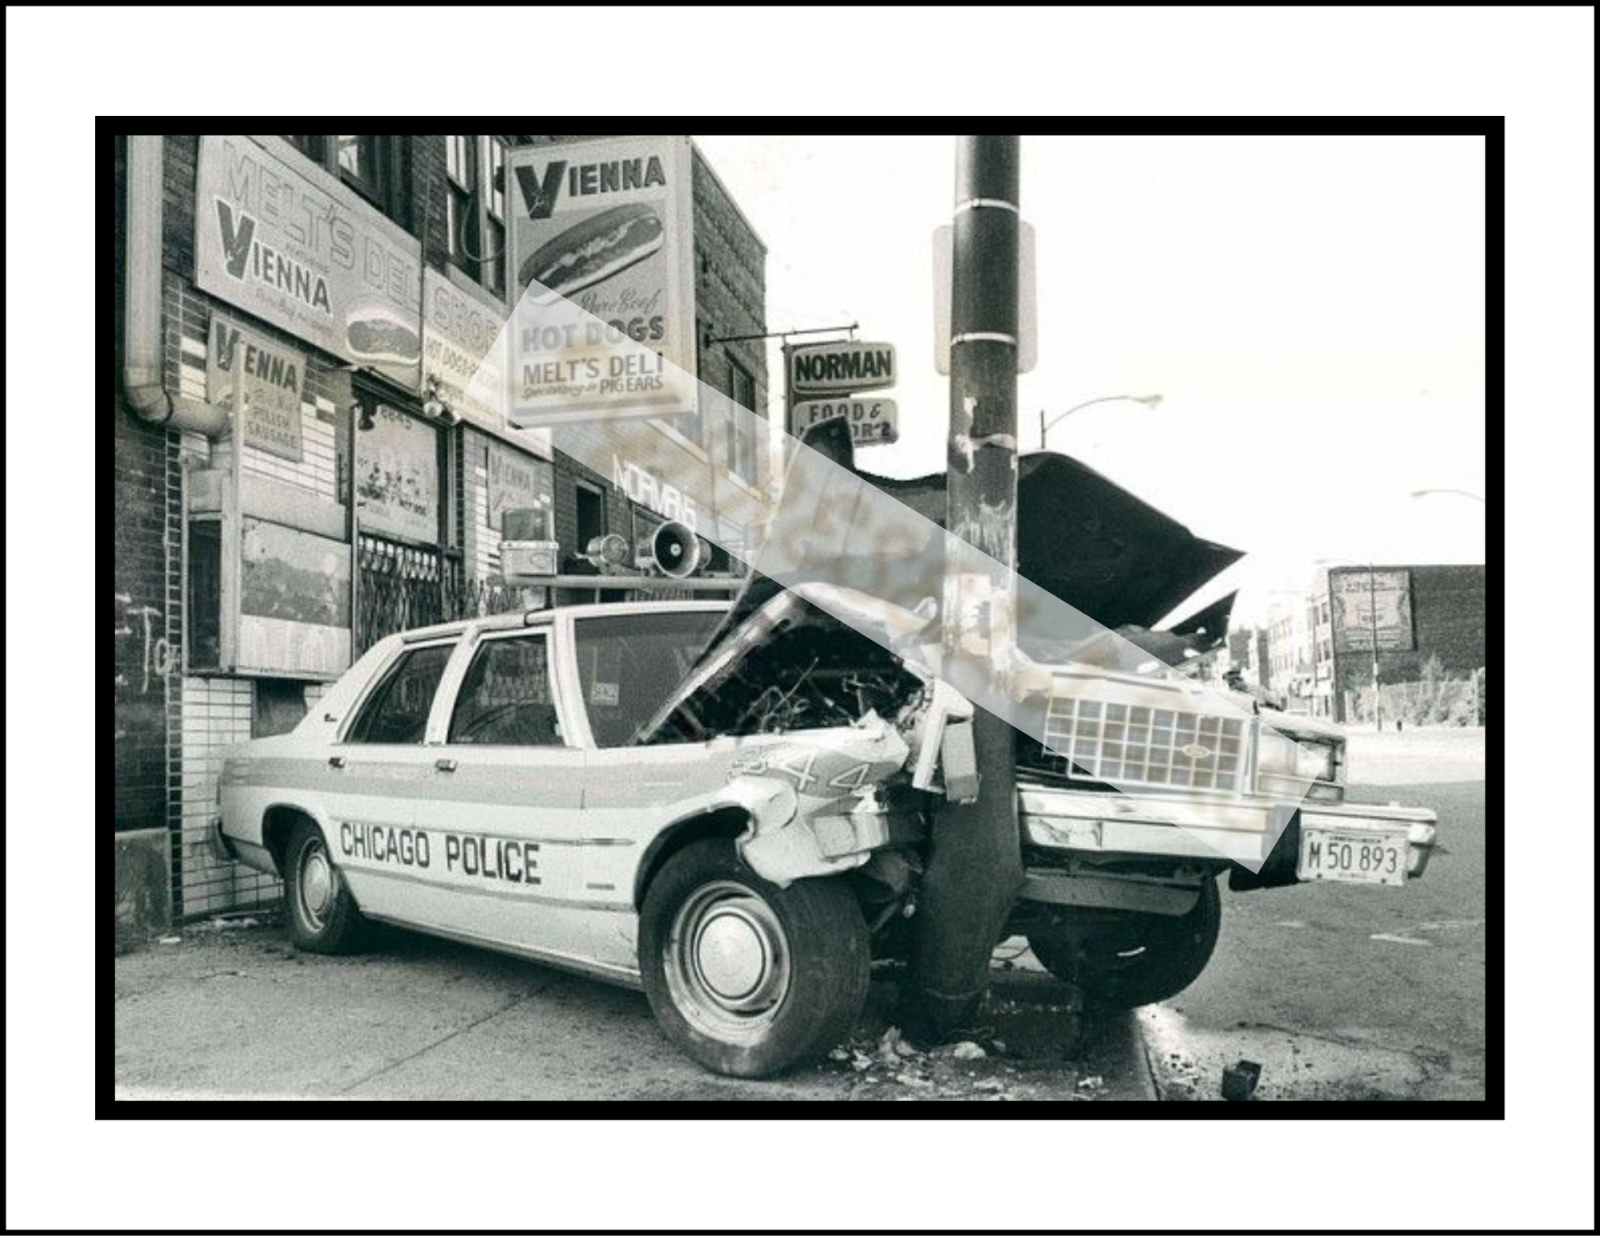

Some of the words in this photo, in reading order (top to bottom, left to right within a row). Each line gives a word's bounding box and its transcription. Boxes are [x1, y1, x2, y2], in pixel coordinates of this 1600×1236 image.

[224, 139, 356, 271] MELT'S
[514, 156, 666, 220] VIENNA
[215, 199, 331, 314] VIENNA
[522, 323, 579, 352] HOT
[586, 315, 664, 346] DOGS
[215, 322, 298, 394] VENNA
[523, 357, 600, 385] MELT'S
[609, 352, 664, 377] DELI
[795, 350, 891, 381] NORMAN
[599, 378, 626, 394] PIG
[626, 375, 664, 393] EARS
[809, 402, 864, 423] FOOD
[869, 402, 882, 418] &
[340, 822, 430, 868] CHICAGO
[446, 834, 542, 884] POLICE
[1308, 842, 1321, 868] M
[1327, 842, 1352, 870] 50
[1360, 846, 1397, 873] 893
